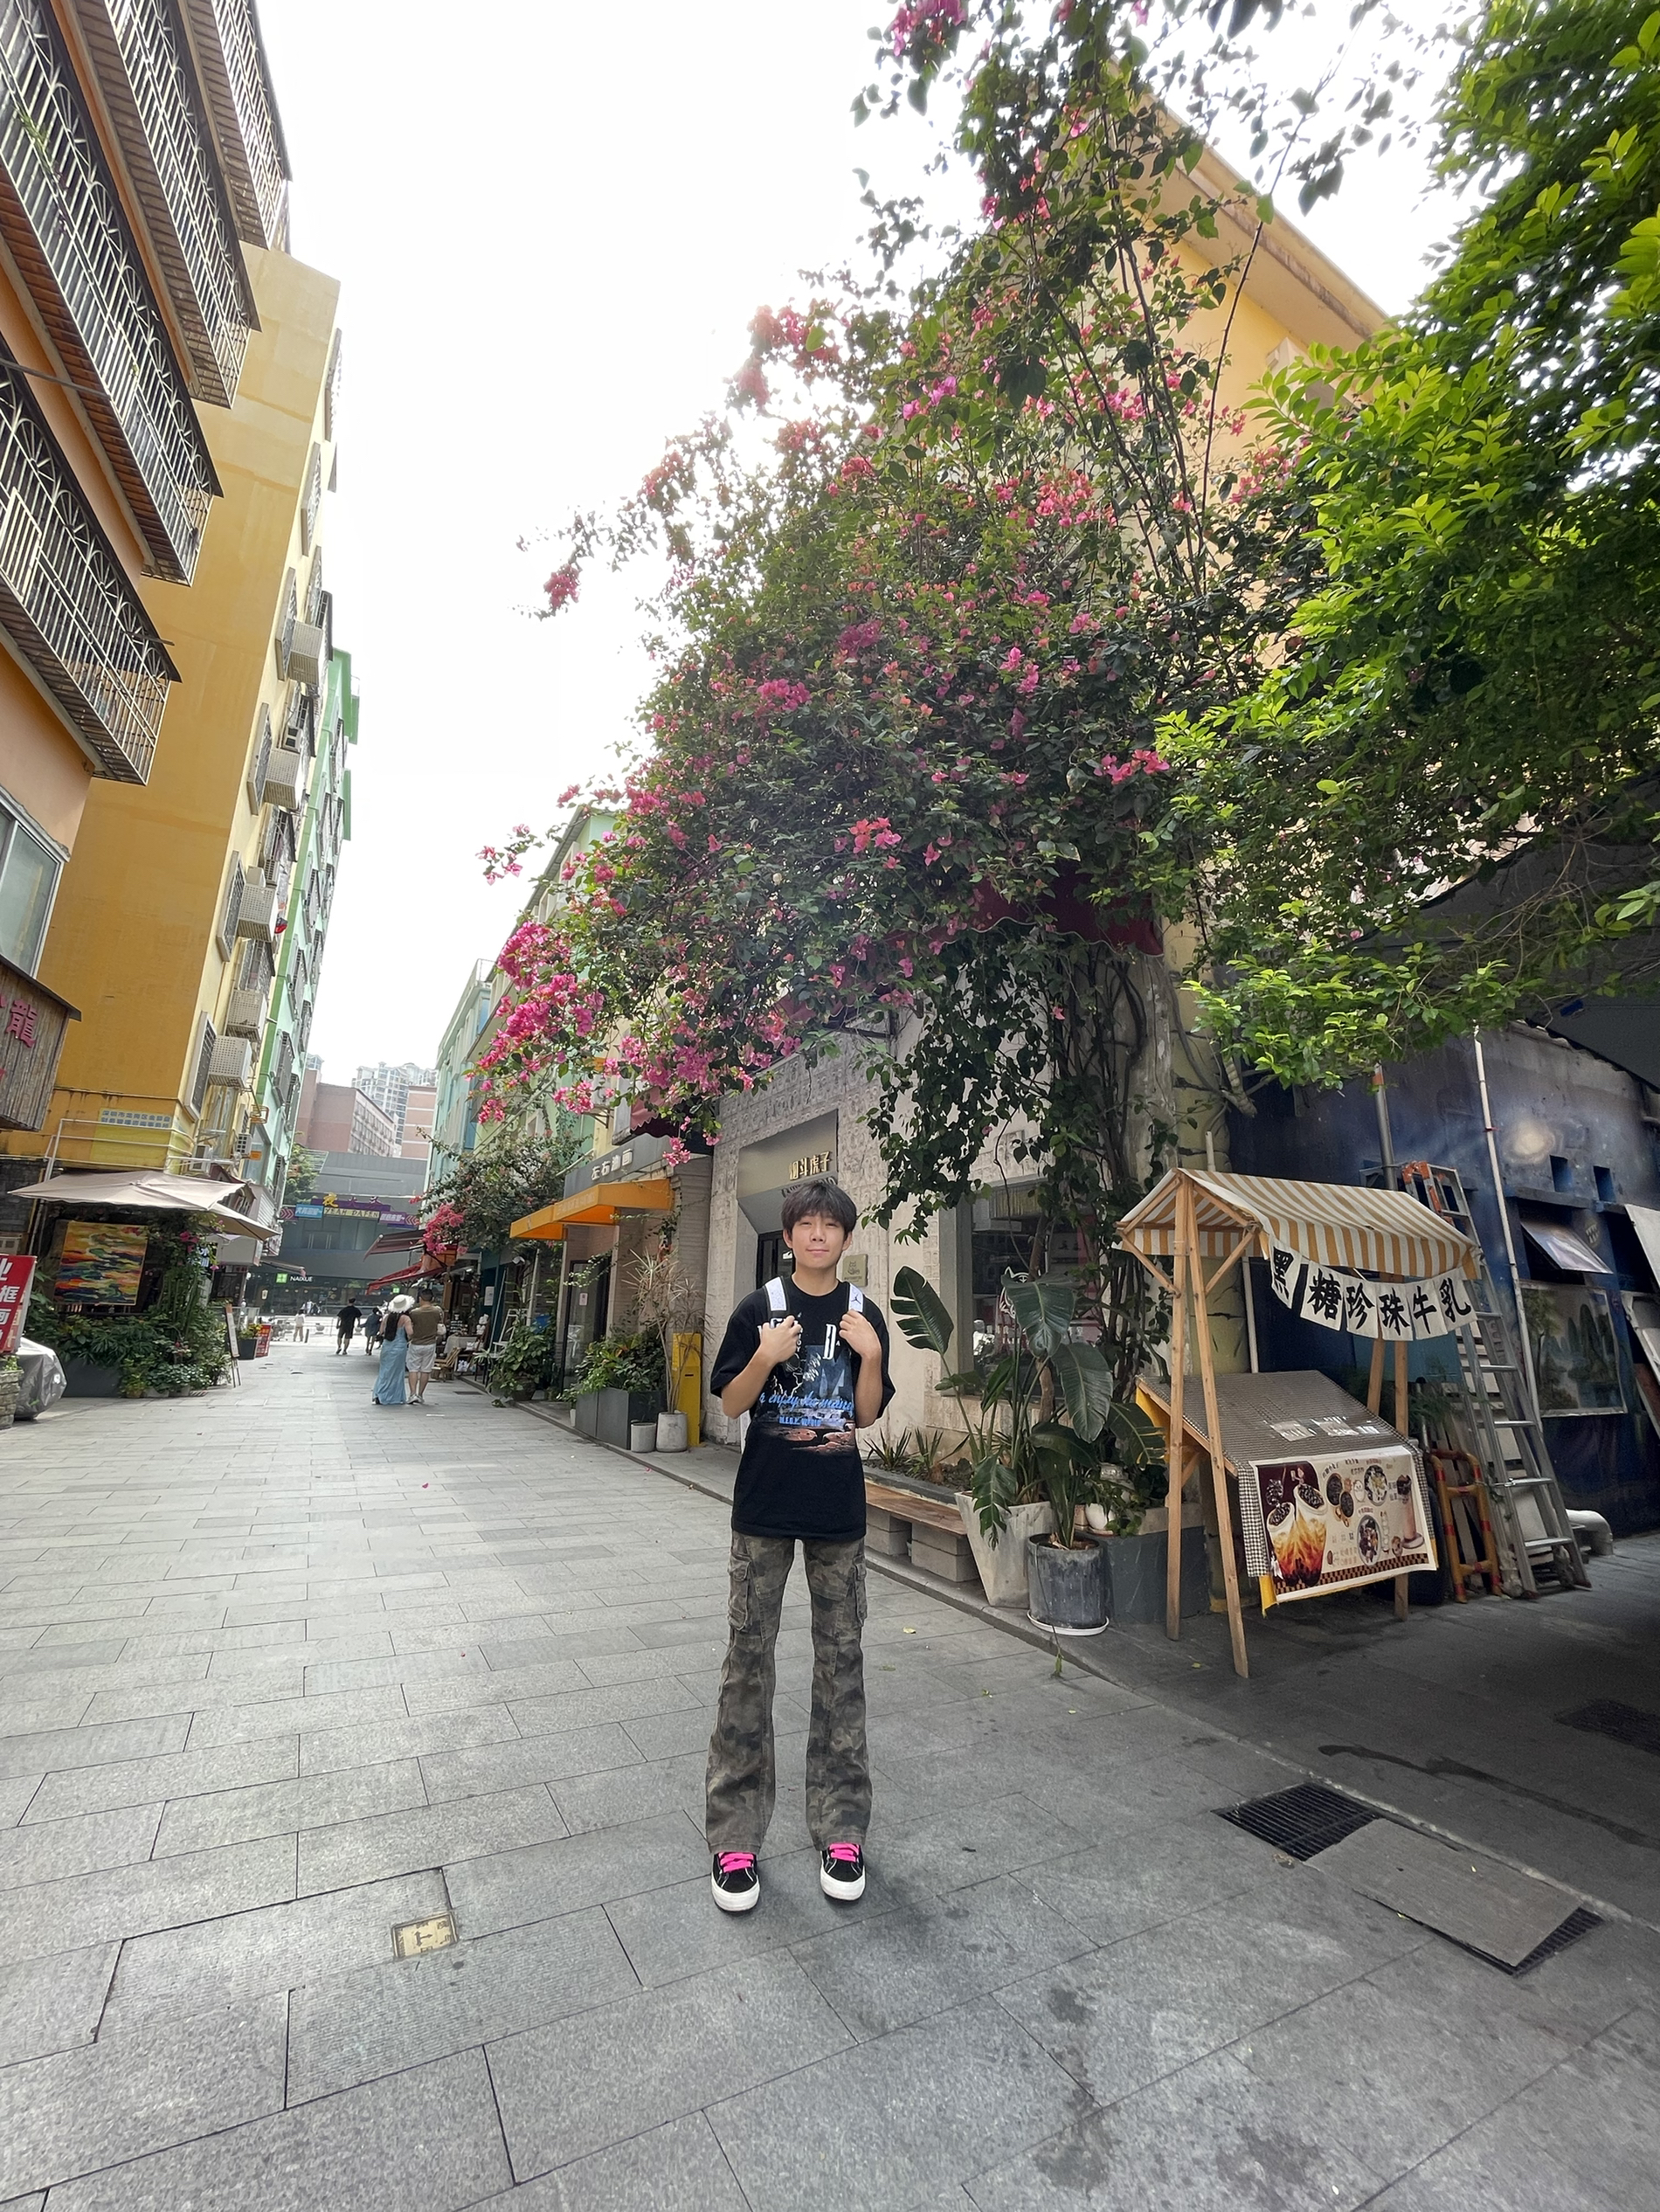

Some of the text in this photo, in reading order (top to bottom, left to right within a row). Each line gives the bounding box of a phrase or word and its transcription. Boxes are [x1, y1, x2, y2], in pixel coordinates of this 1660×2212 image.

[1272, 1246, 1471, 1337] 黑糖珍珠牛乳
